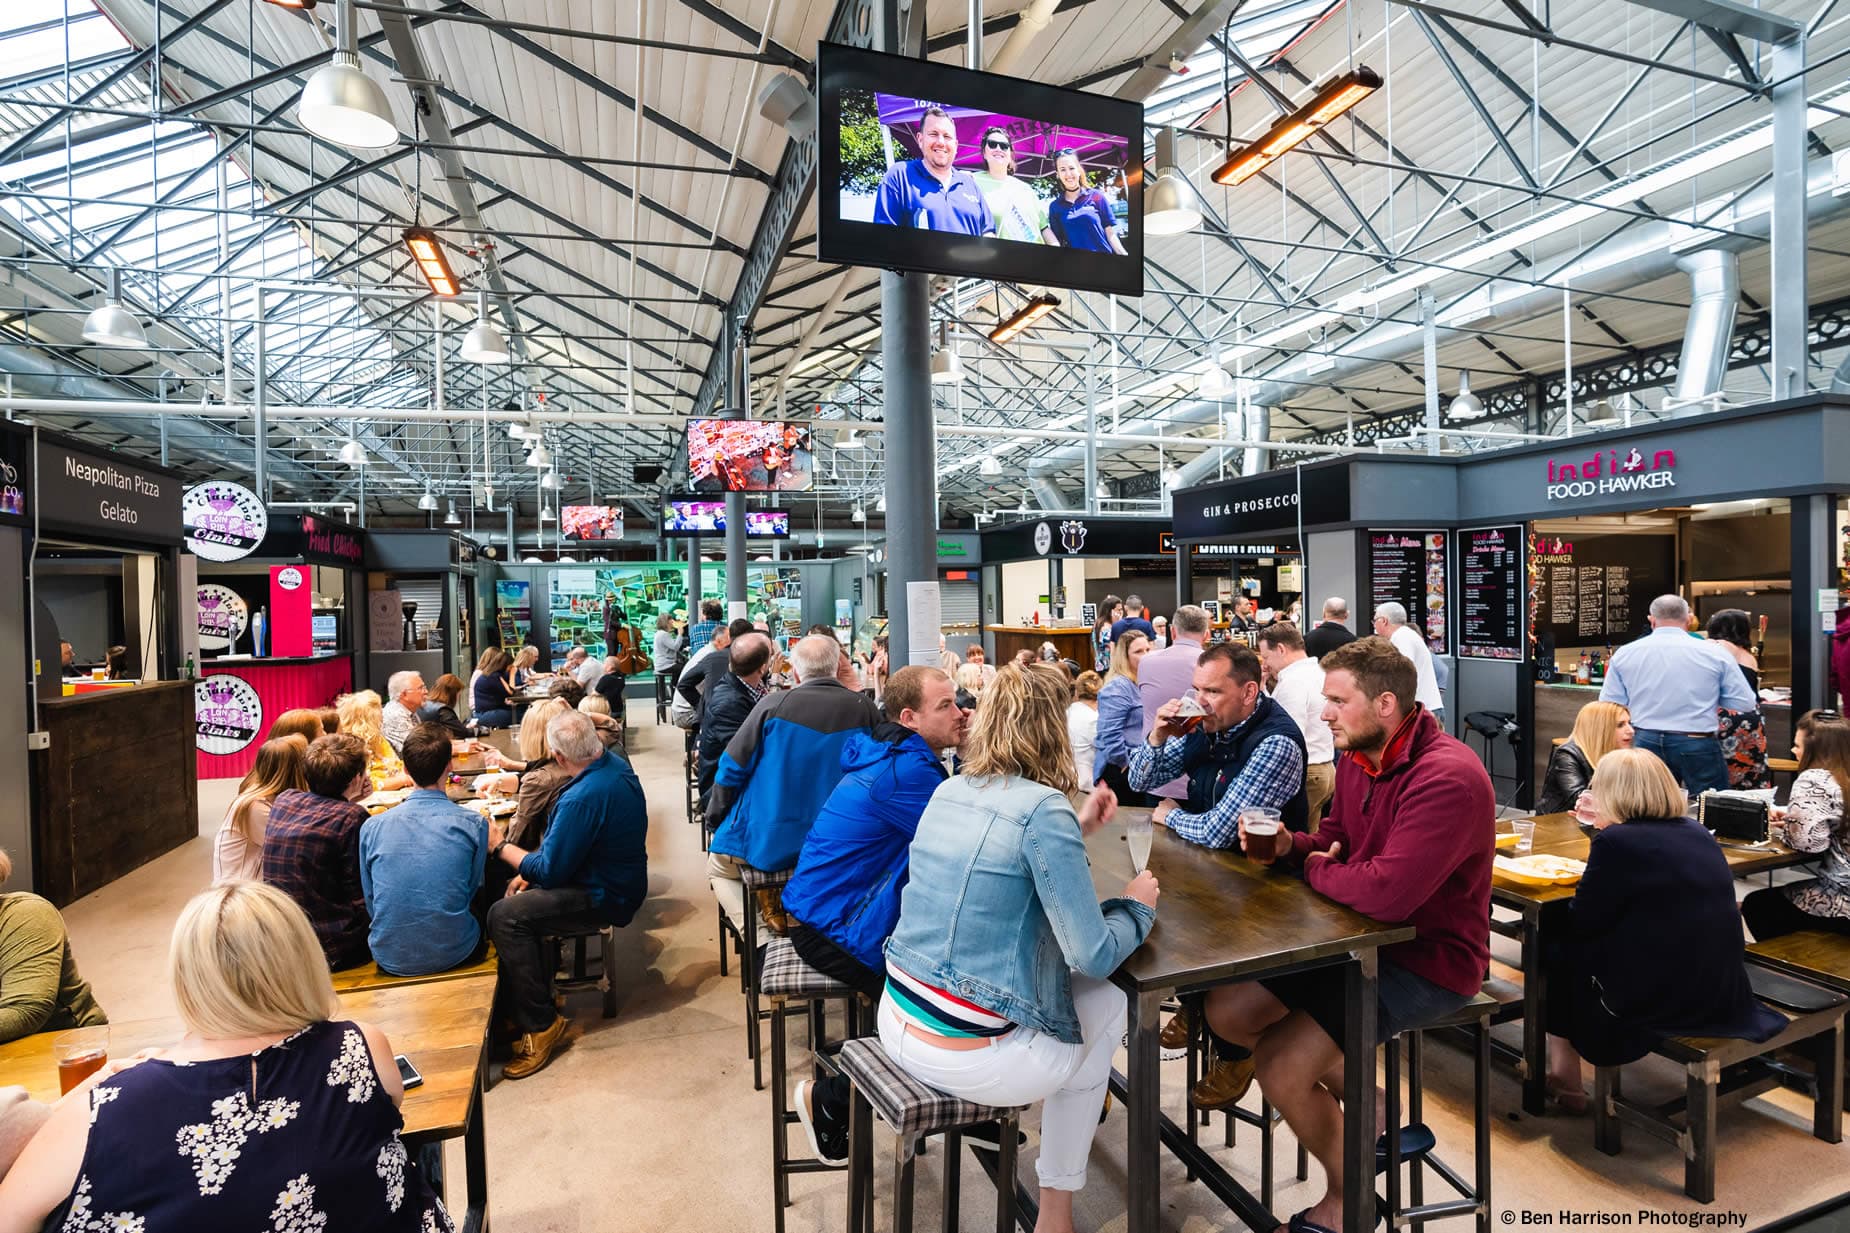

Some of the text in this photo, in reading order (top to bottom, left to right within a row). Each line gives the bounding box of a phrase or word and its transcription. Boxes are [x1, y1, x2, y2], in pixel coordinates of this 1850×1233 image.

[65, 456, 159, 497] Neapolitan Pizza
[1548, 448, 1675, 483] Indian
[1547, 471, 1675, 500] FOOD HAWKER
[100, 500, 138, 524] Gelato
[1203, 493, 1299, 518] GIN & PROSECCO
[1544, 554, 1572, 563] HAWKER
